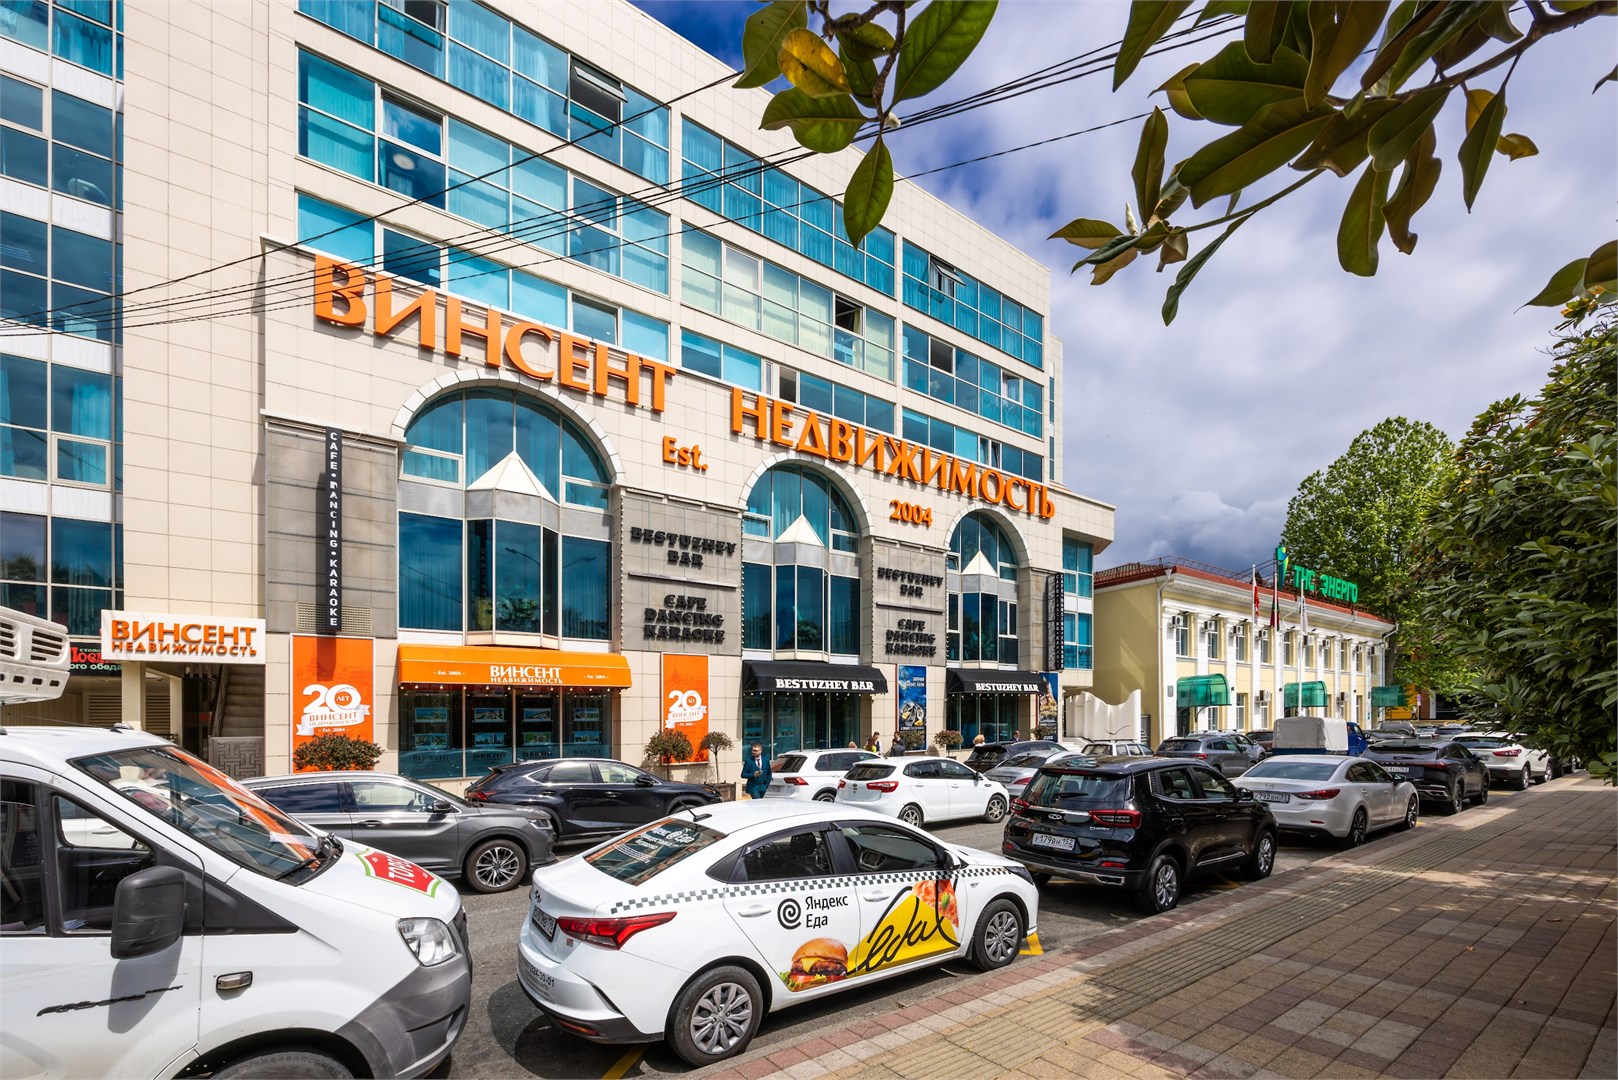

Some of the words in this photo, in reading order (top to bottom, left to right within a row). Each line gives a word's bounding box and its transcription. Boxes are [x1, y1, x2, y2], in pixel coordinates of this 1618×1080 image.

[315, 254, 676, 412] ВИНСЕНТ
[329, 432, 338, 470] CAFE
[663, 436, 708, 471] Est.
[731, 387, 1056, 519] НЕДВИЖИМОСТЬ
[329, 481, 338, 548] DANCING
[889, 499, 933, 527] 2004
[630, 526, 738, 555] BESTUZHEY
[667, 549, 704, 567] BAR
[329, 559, 338, 626] KARAOKE
[900, 584, 924, 597] BAR
[1320, 574, 1359, 603] ЭНЕРГО
[663, 594, 707, 610] CAFE
[644, 608, 725, 626] DANCING
[897, 618, 926, 630] CAFE
[111, 619, 257, 645] ВИНСЕНТ
[643, 624, 726, 642] KARAOKE
[111, 641, 257, 656] НЕДВИЖИМОСТЬ
[490, 665, 561, 678] ВИНСЕНТ
[775, 679, 849, 690] BESTUZHEY
[850, 680, 875, 691] BAR
[975, 682, 1022, 691] BESTUZHEY
[1022, 683, 1040, 692] BAR
[303, 684, 362, 714] 20
[668, 690, 702, 712] 20
[309, 711, 358, 722] ВИНСЕНТ
[1061, 838, 1073, 846] 152
[805, 895, 849, 910] Яндекс
[806, 914, 828, 929] Еда
